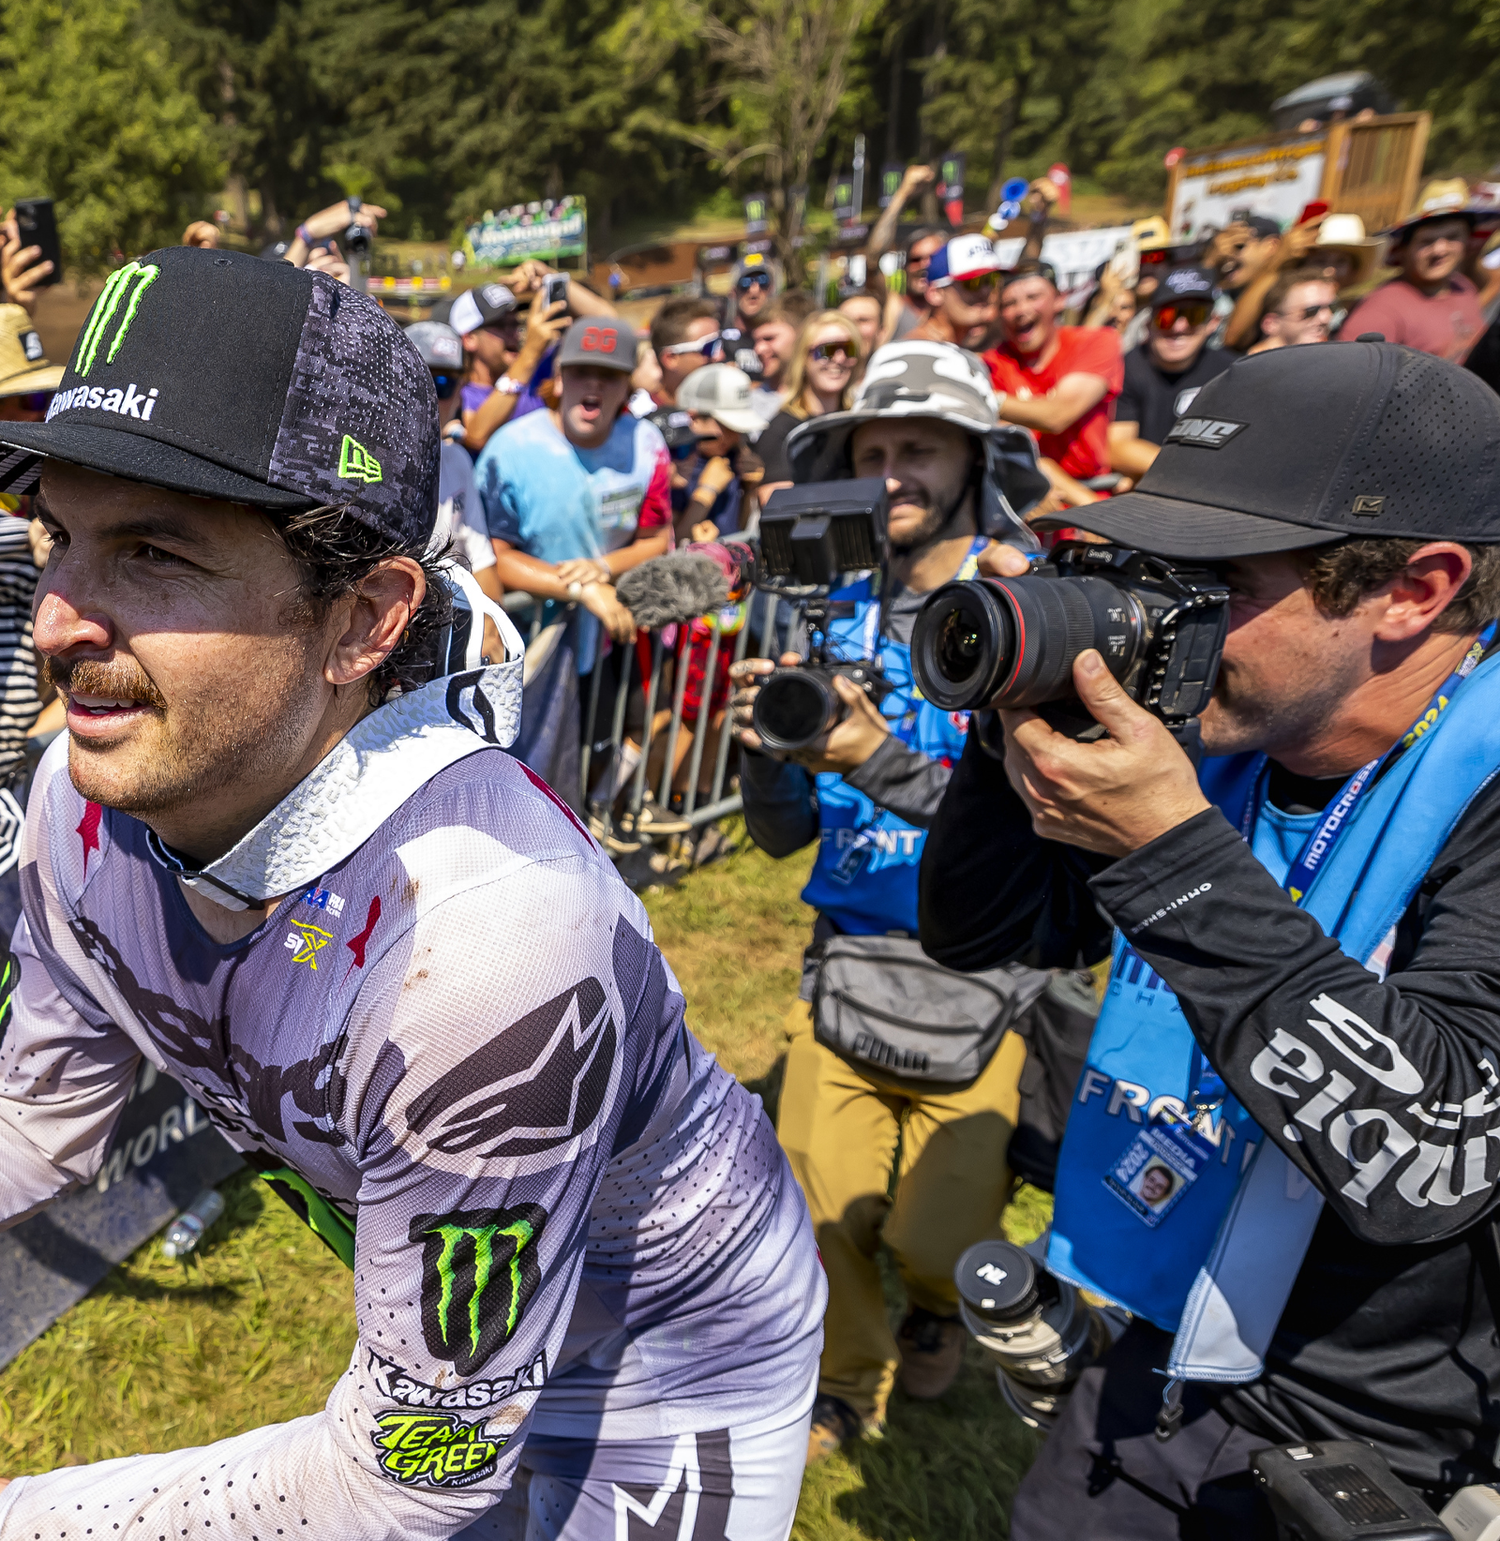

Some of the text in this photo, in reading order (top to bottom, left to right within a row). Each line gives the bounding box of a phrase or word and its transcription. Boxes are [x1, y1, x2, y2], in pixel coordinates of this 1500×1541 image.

[1401, 695, 1449, 749] 2024
[1303, 759, 1379, 871] MOTOCROSS
[820, 827, 923, 855] FRNT
[96, 1096, 209, 1194] WORL
[1115, 1141, 1150, 1183] 2024
[1150, 1126, 1196, 1170] MEDIA
[368, 1349, 547, 1410] Kawasaki
[376, 1414, 482, 1451] TEAM
[451, 1465, 493, 1486] Kawasaki
